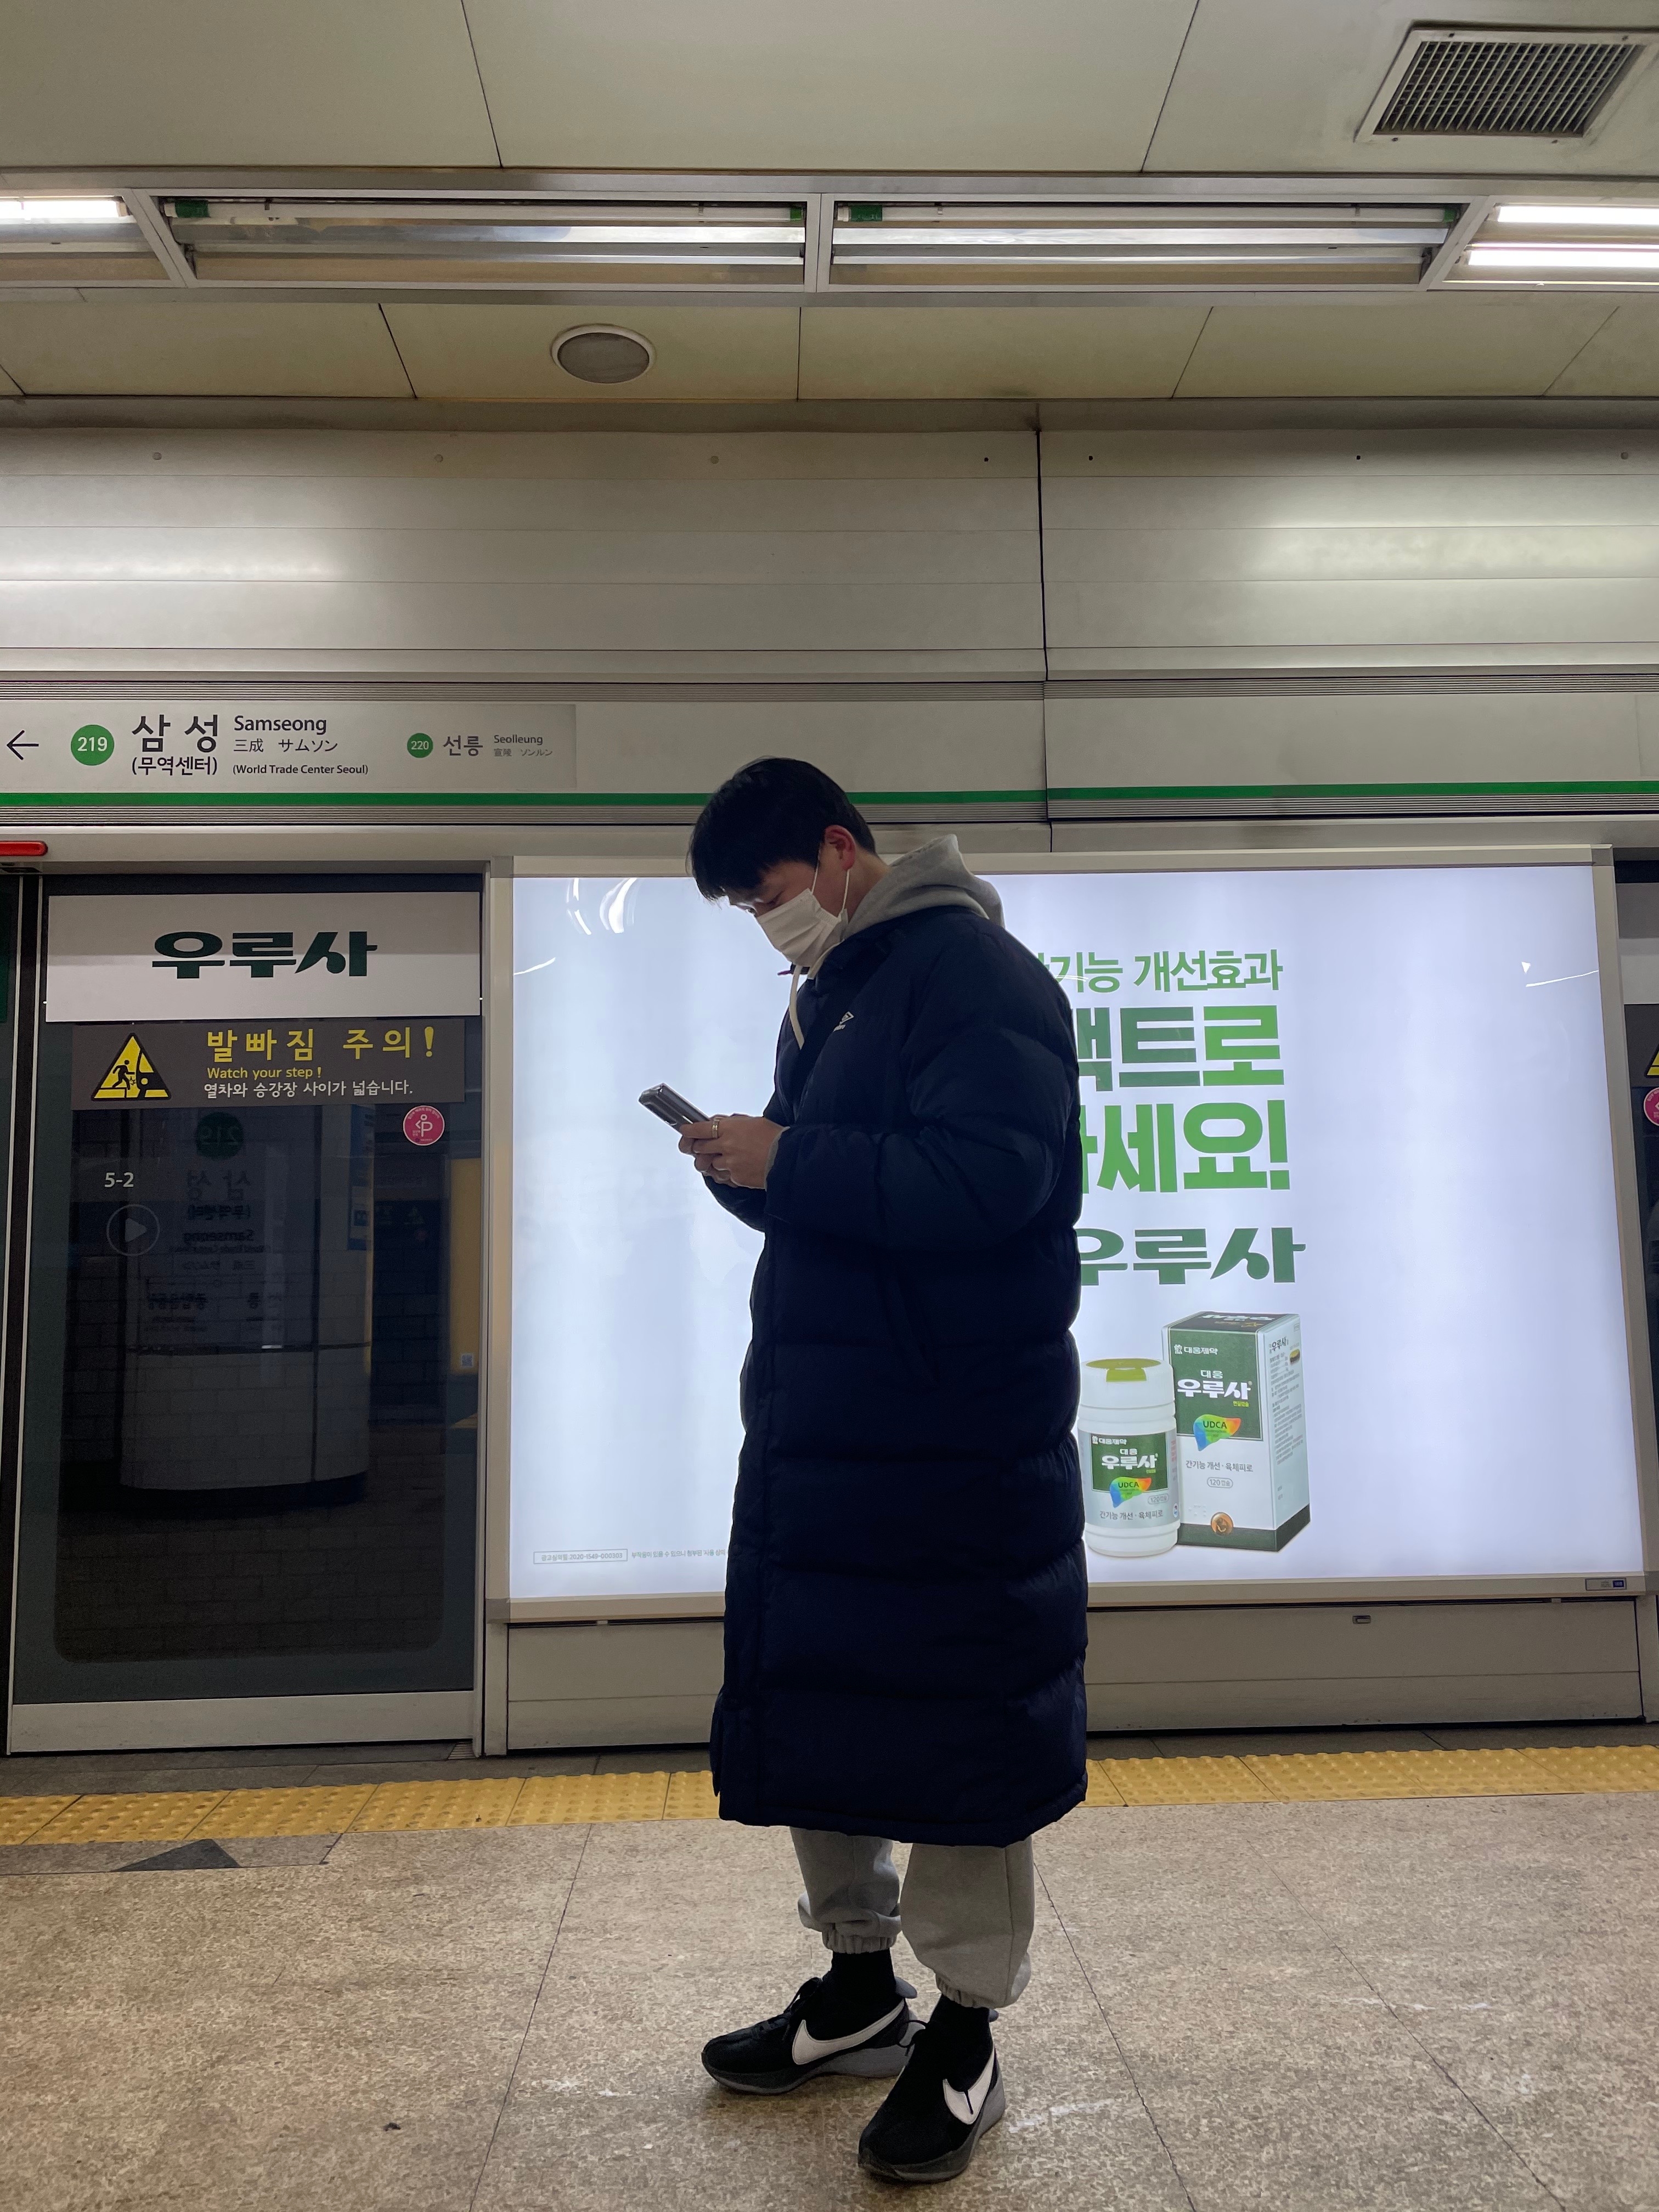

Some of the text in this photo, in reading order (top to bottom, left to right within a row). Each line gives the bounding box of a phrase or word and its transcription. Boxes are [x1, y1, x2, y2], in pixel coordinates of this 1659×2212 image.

[234, 715, 327, 734] Samseong
[77, 736, 108, 752] 219
[233, 738, 338, 753] 三成 サムソン
[411, 741, 430, 750] 220
[443, 735, 483, 757] 선릉
[494, 734, 543, 746] Seolleung
[132, 756, 217, 776] (무역센터)
[233, 764, 368, 775] (World Trade Center Seoul)
[152, 931, 378, 979] 우루사
[1133, 949, 1284, 992] 개선효과
[208, 1068, 249, 1079] Watch
[252, 1070, 281, 1080] your
[286, 1068, 313, 1079] step
[204, 1079, 413, 1099] 열차와 승강장 사이가 넓습니다.
[1080, 1099, 1290, 1194] 세요!
[104, 1172, 134, 1188] 5-2
[1200, 1369, 1223, 1379] 대웅
[1177, 1378, 1251, 1400] 우루사
[1203, 1420, 1227, 1429] UDCA
[1101, 1454, 1158, 1470] 우루사
[1186, 1460, 1254, 1472] 간기능 개선 육체피로
[1099, 1510, 1119, 1520] 간기능
[1120, 1512, 1133, 1520] 개선
